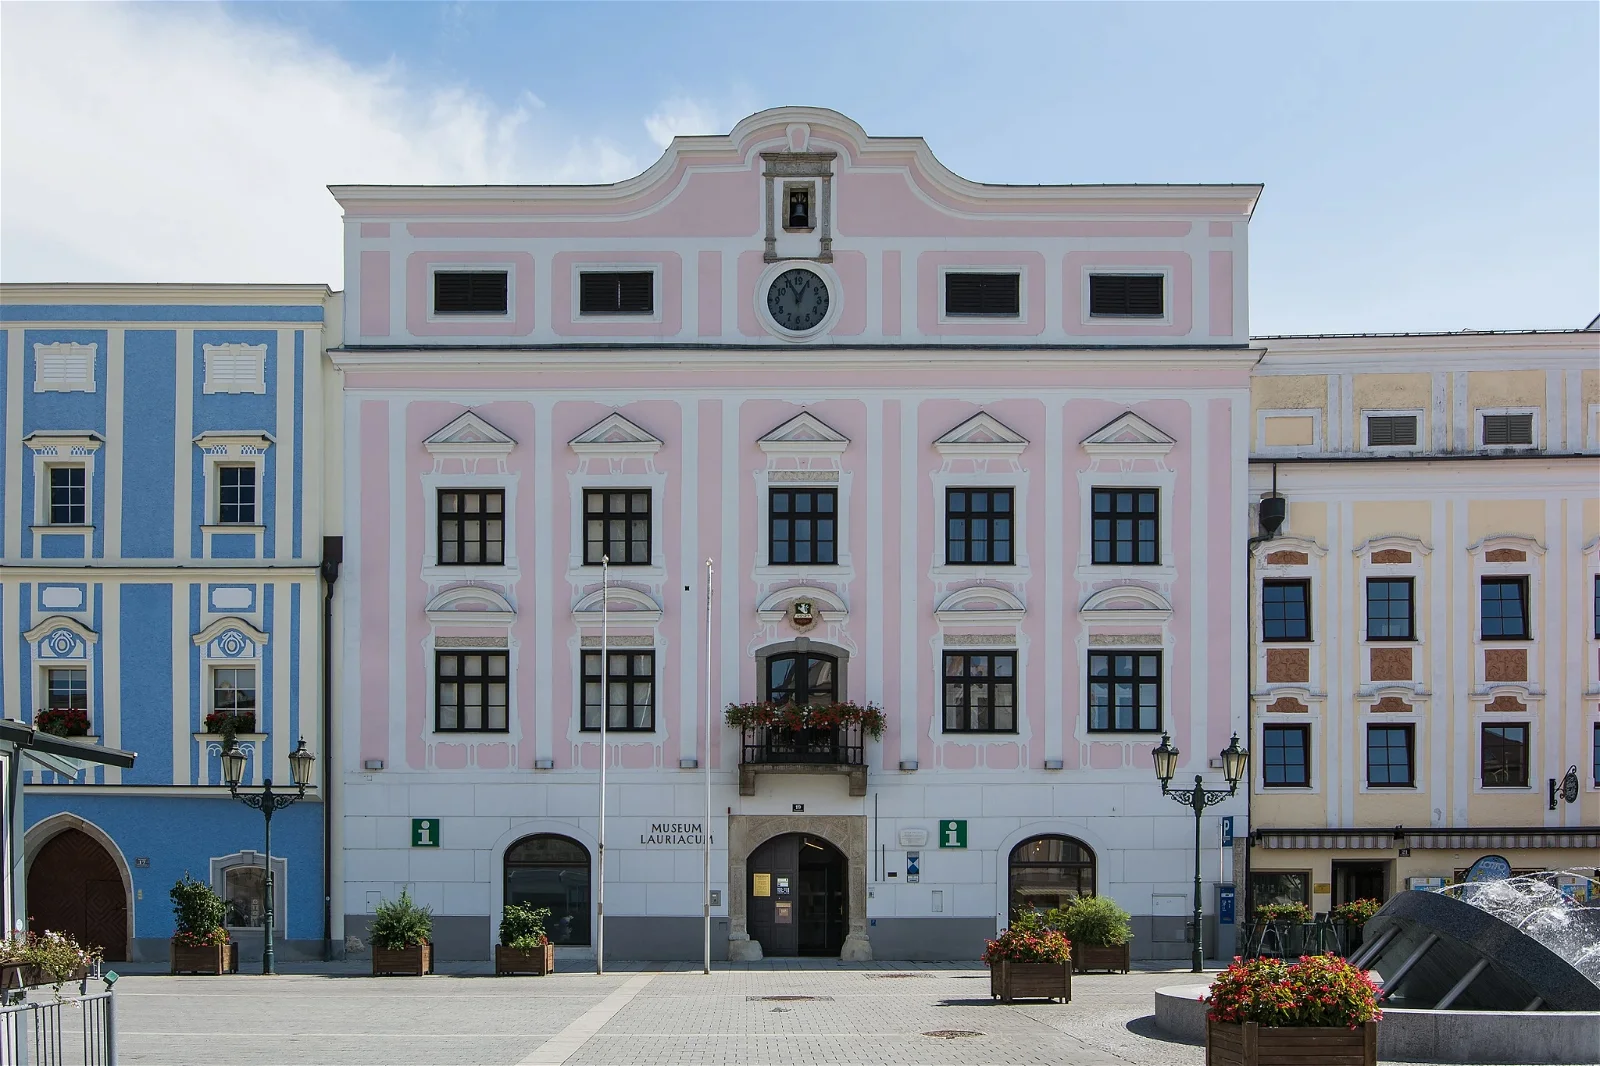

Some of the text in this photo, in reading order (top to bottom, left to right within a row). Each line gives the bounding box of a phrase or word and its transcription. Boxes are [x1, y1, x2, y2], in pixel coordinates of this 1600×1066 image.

[794, 277, 803, 285] 12
[778, 288, 786, 296] 10
[814, 286, 819, 296] 2
[817, 297, 822, 305] 3
[812, 306, 817, 315] 4
[787, 313, 792, 321] 7
[796, 316, 800, 324] 6
[805, 314, 810, 322] 5
[652, 824, 702, 833] MUSEUM
[1224, 820, 1230, 836] P
[640, 835, 714, 844] LAURIACUM
[1479, 861, 1506, 871] LOTTO
